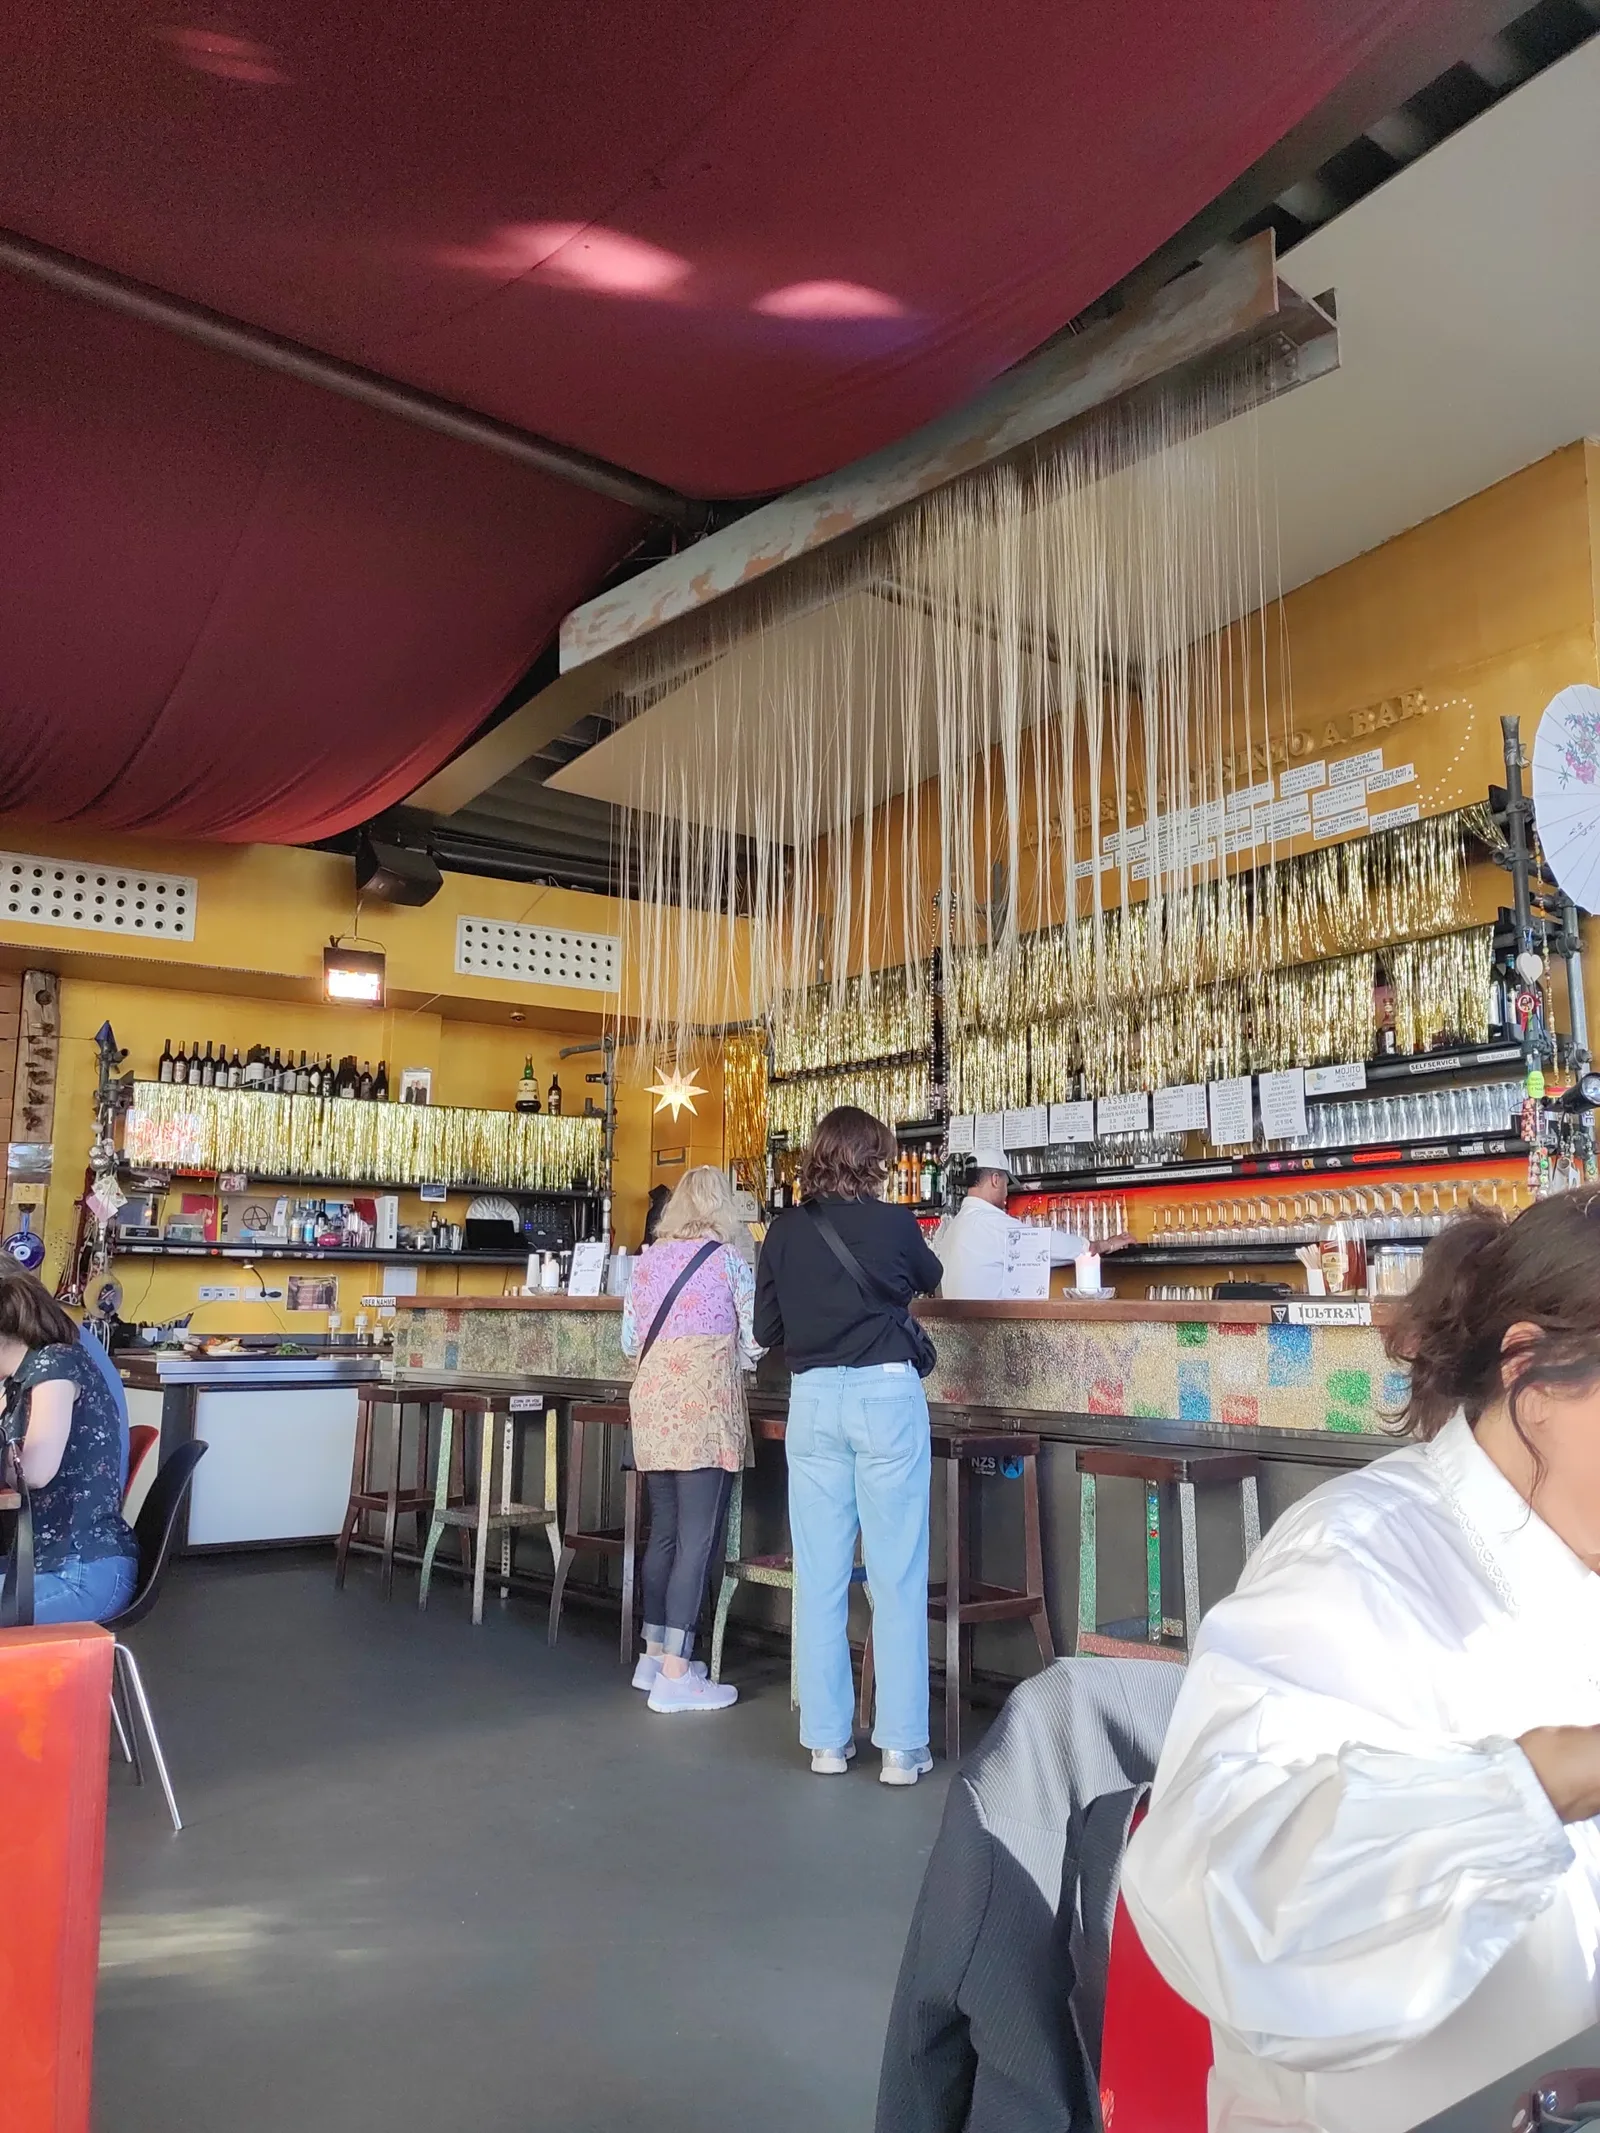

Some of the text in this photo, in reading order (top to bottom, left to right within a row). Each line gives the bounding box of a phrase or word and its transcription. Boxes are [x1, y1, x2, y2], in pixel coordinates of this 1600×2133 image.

[1349, 688, 1428, 739] BAR
[1356, 752, 1372, 760] TOILET
[1330, 771, 1343, 779] UNTIL
[1368, 777, 1389, 786] NAPKINS
[1391, 771, 1406, 779] START
[1399, 805, 1416, 814] HAPPY
[1340, 811, 1360, 821] MIRROR
[1371, 812, 1411, 827] HOUR EXTENDS
[1327, 819, 1352, 830] REFLECTS
[1334, 1065, 1360, 1075] MOJITO
[1410, 1058, 1457, 1070] SELFSERVICE
[1102, 1093, 1142, 1105] FASSBIER
[1304, 1306, 1355, 1319] ULTRA
[971, 1456, 996, 1468] NZS
